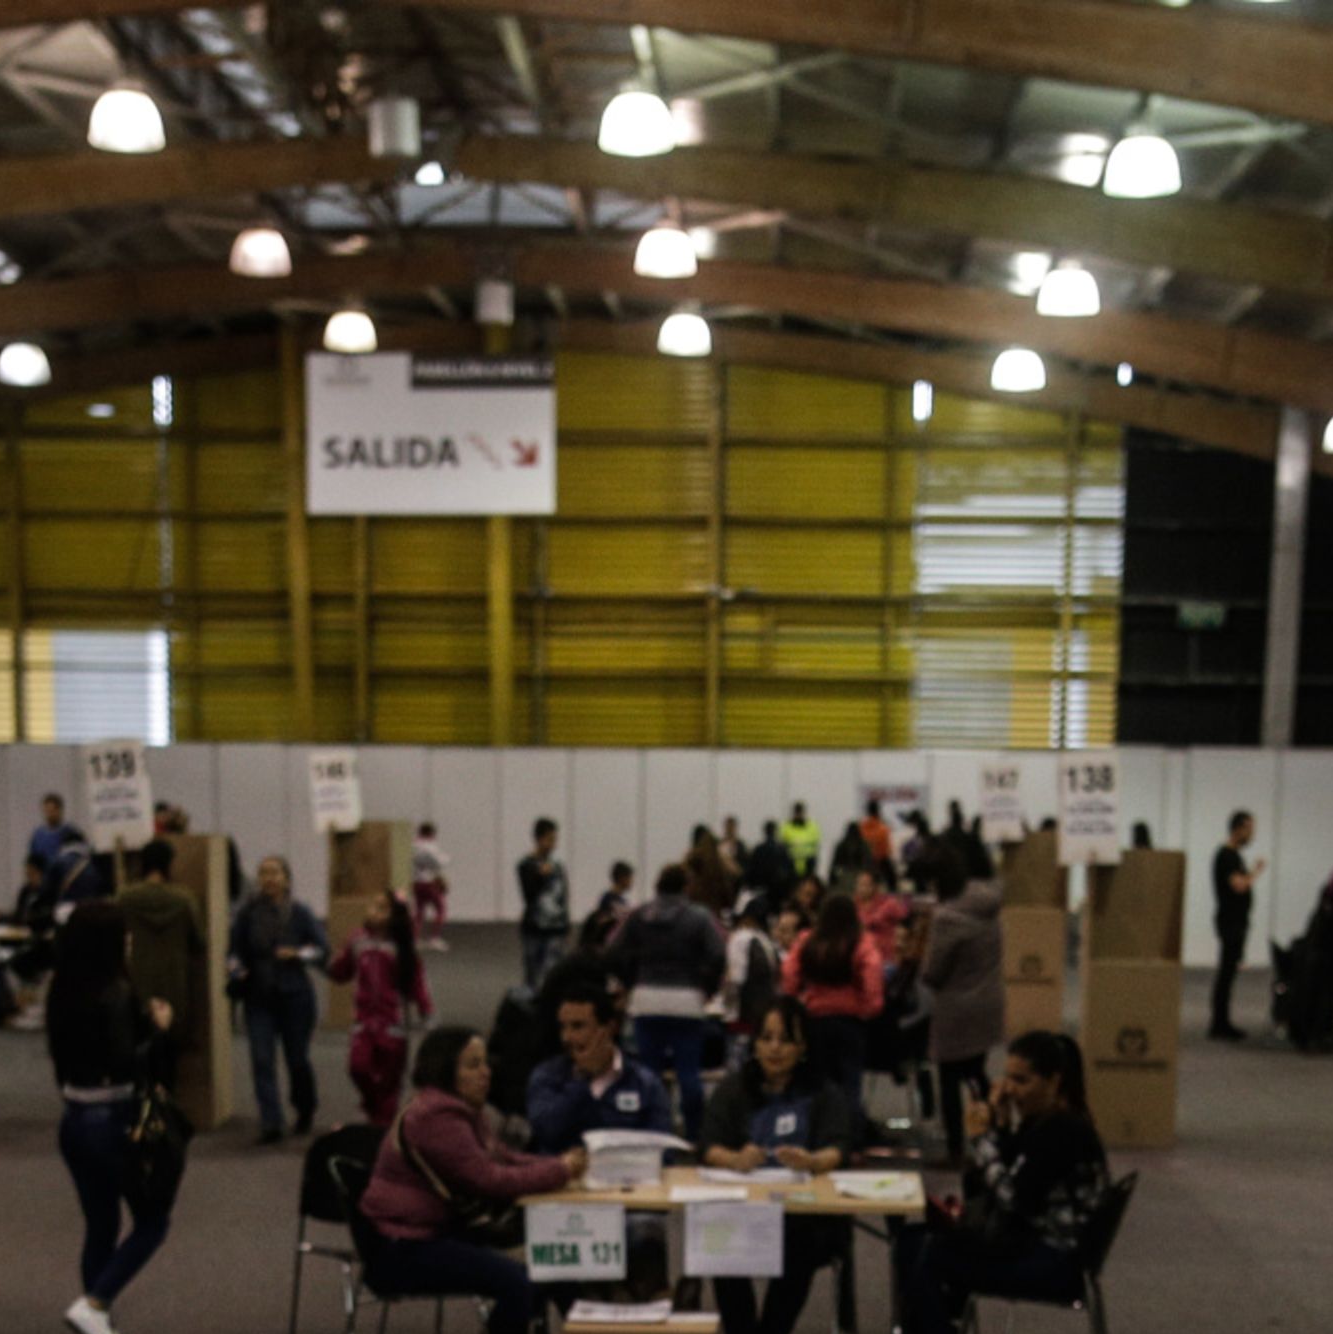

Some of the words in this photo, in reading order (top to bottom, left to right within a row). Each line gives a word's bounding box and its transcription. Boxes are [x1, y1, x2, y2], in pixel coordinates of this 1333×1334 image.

[323, 435, 460, 469] SALIDA
[1067, 764, 1114, 792] 138
[530, 1242, 580, 1266] MESA
